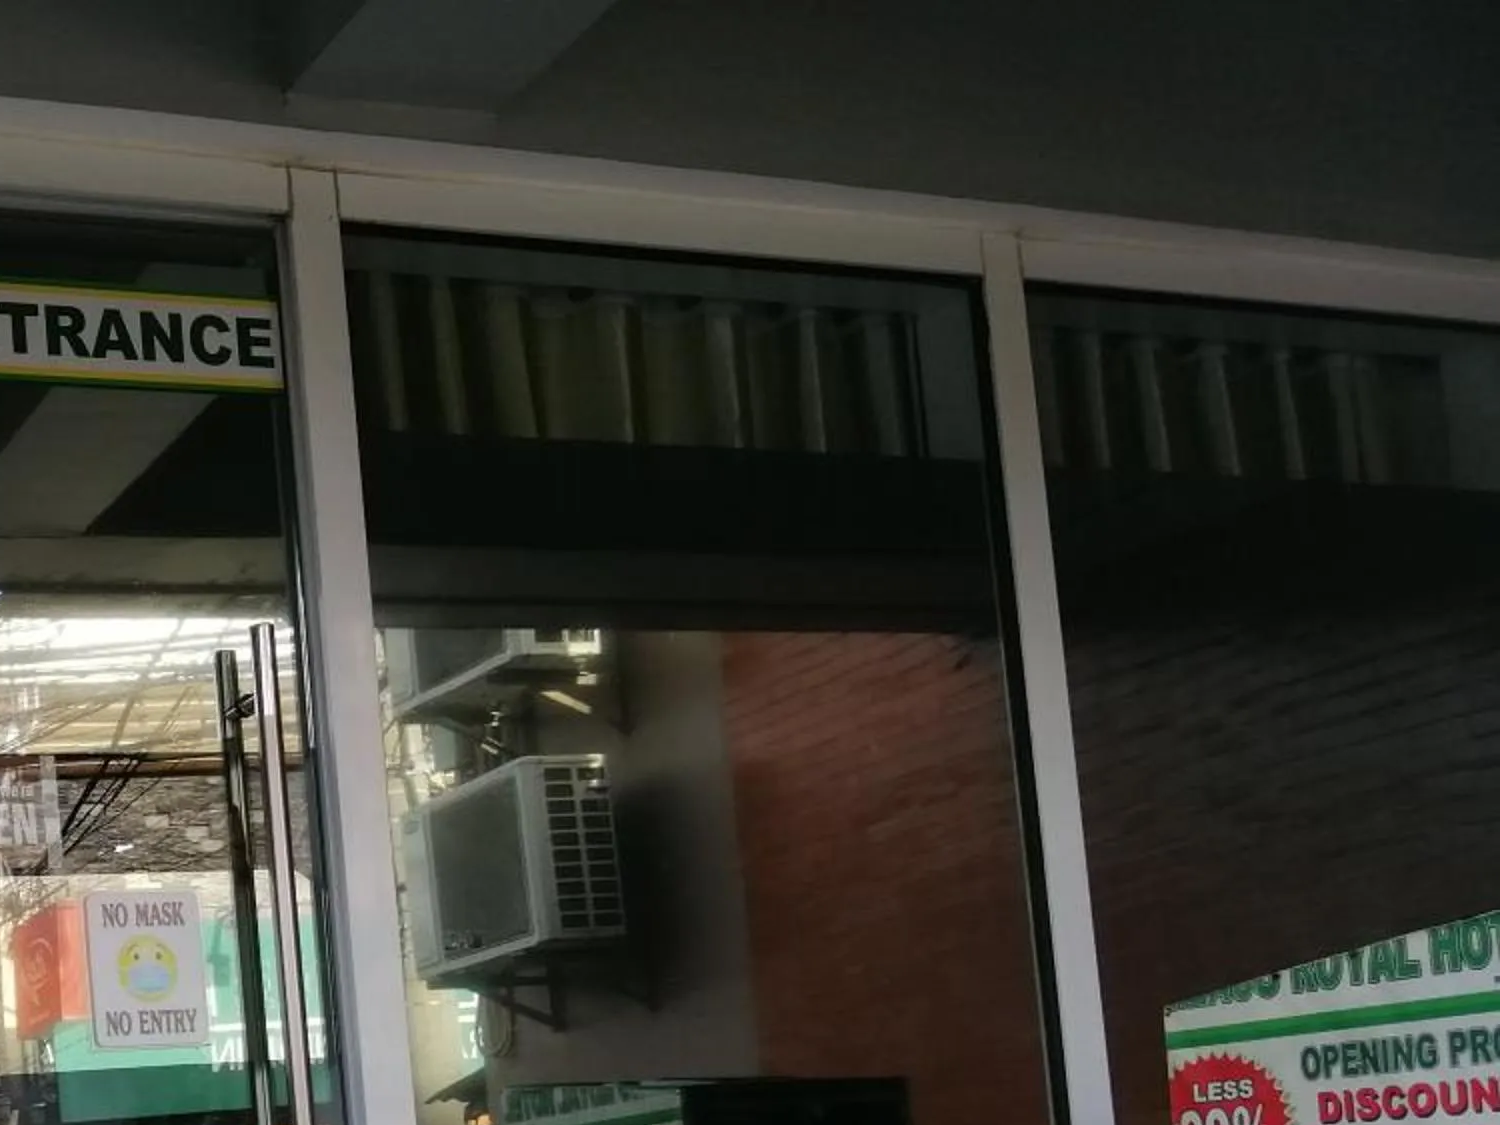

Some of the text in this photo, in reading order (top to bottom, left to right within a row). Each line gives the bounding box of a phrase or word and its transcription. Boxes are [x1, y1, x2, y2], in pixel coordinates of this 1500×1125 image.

[101, 900, 185, 928] NO MASK
[105, 1009, 198, 1037] NO ENTRY
[1301, 1033, 1438, 1081] OPENING
[1193, 1079, 1253, 1103] LESS
